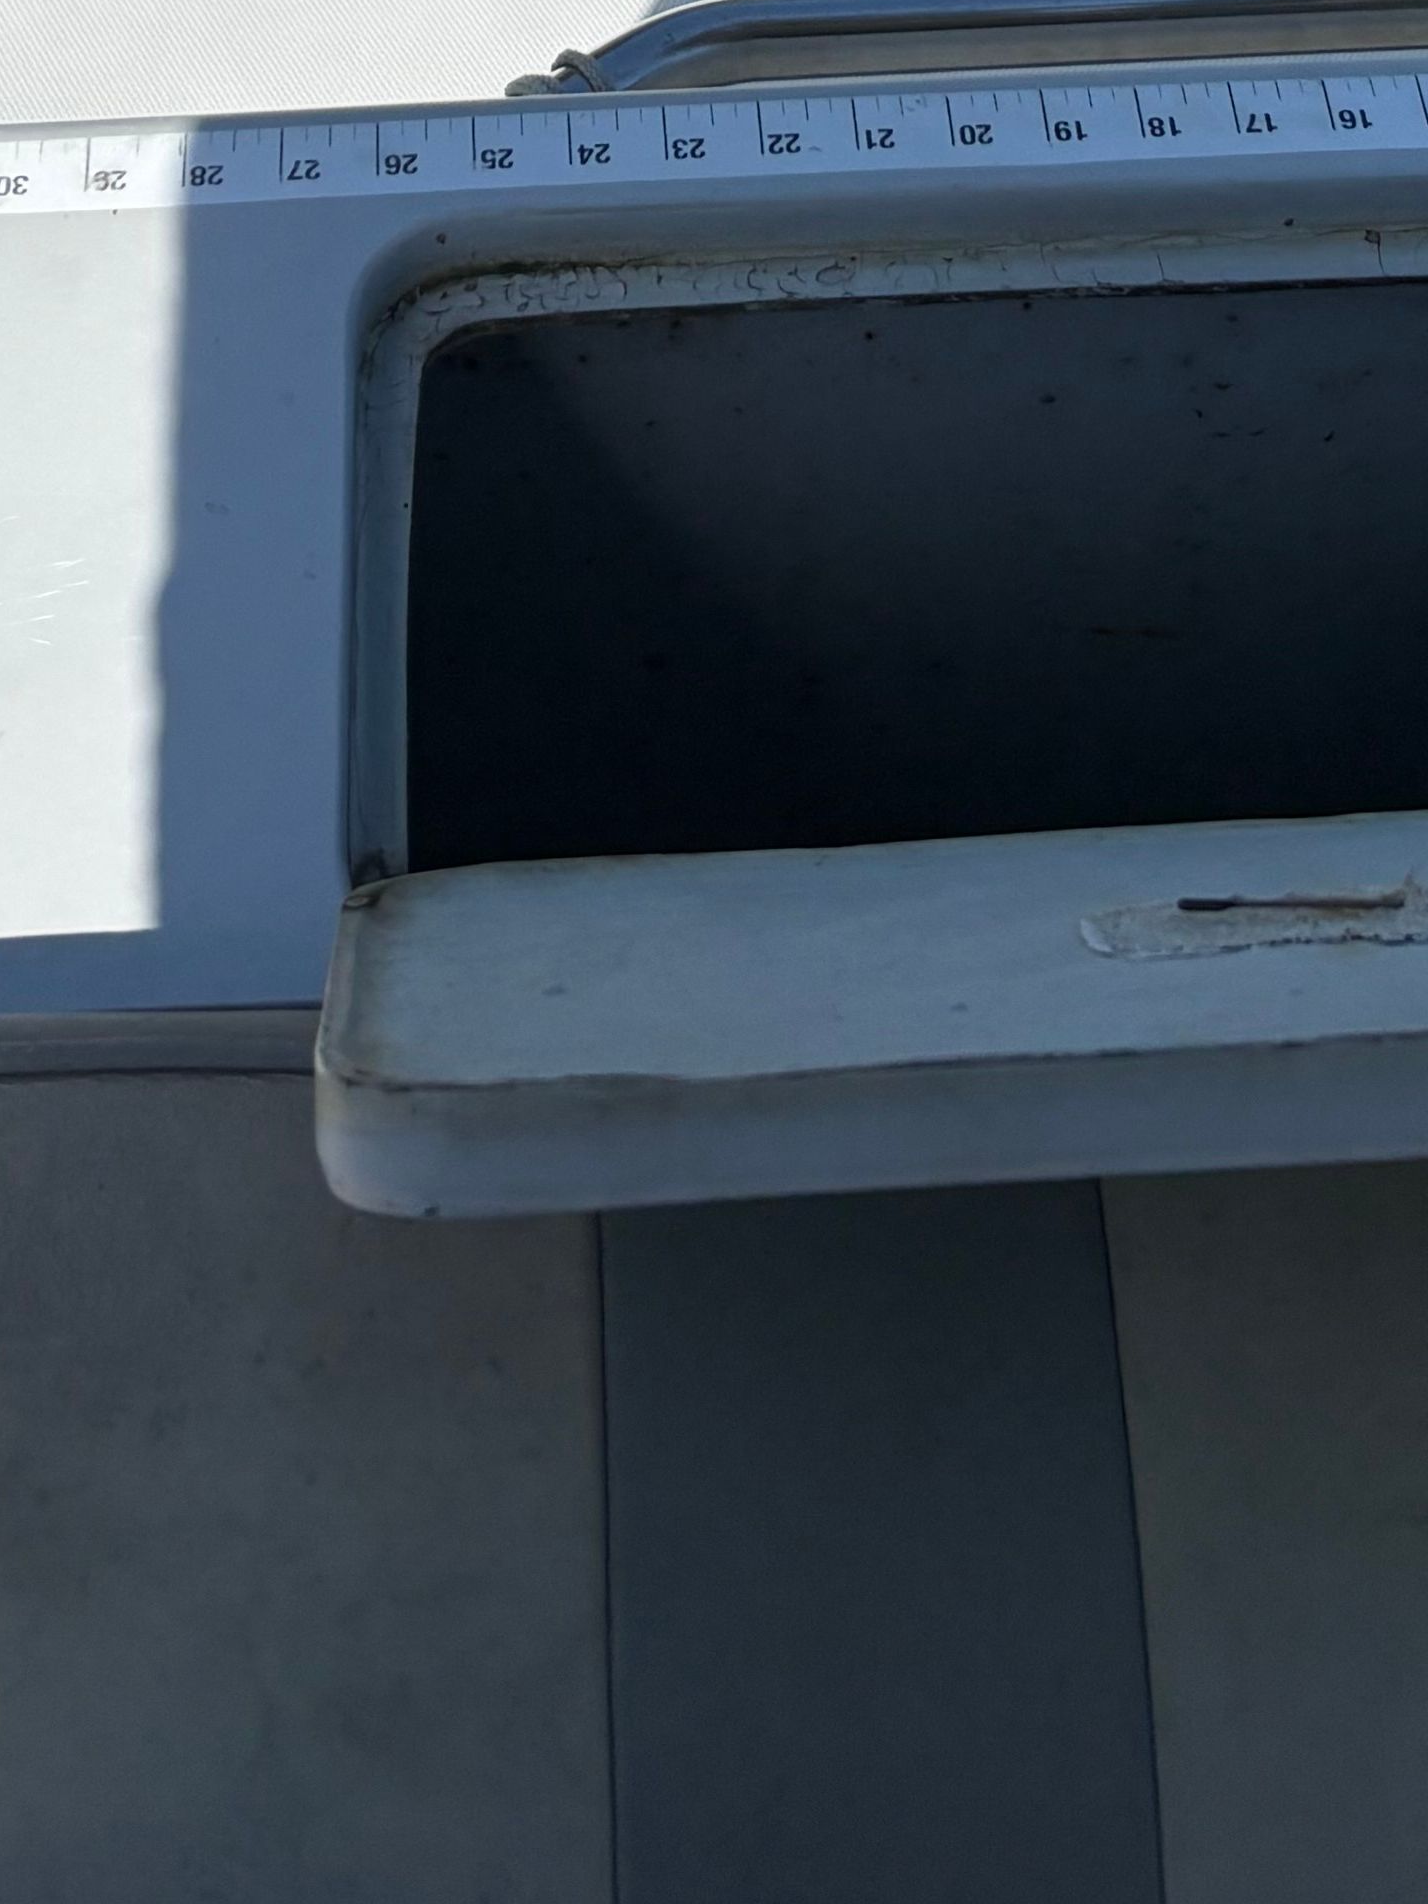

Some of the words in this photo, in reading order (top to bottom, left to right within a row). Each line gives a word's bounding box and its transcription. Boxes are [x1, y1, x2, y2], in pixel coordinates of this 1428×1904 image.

[1147, 116, 1182, 138] 18
[1245, 112, 1278, 134] 17
[1338, 108, 1373, 130] 16
[865, 128, 896, 150] 21
[959, 123, 994, 146] 20
[1054, 120, 1088, 142] 19
[577, 143, 611, 166] 24
[671, 137, 706, 160] 23
[767, 132, 801, 155] 22
[286, 159, 321, 181] 27
[384, 153, 418, 176] 26
[480, 148, 514, 170] 25
[190, 165, 224, 187] 28
